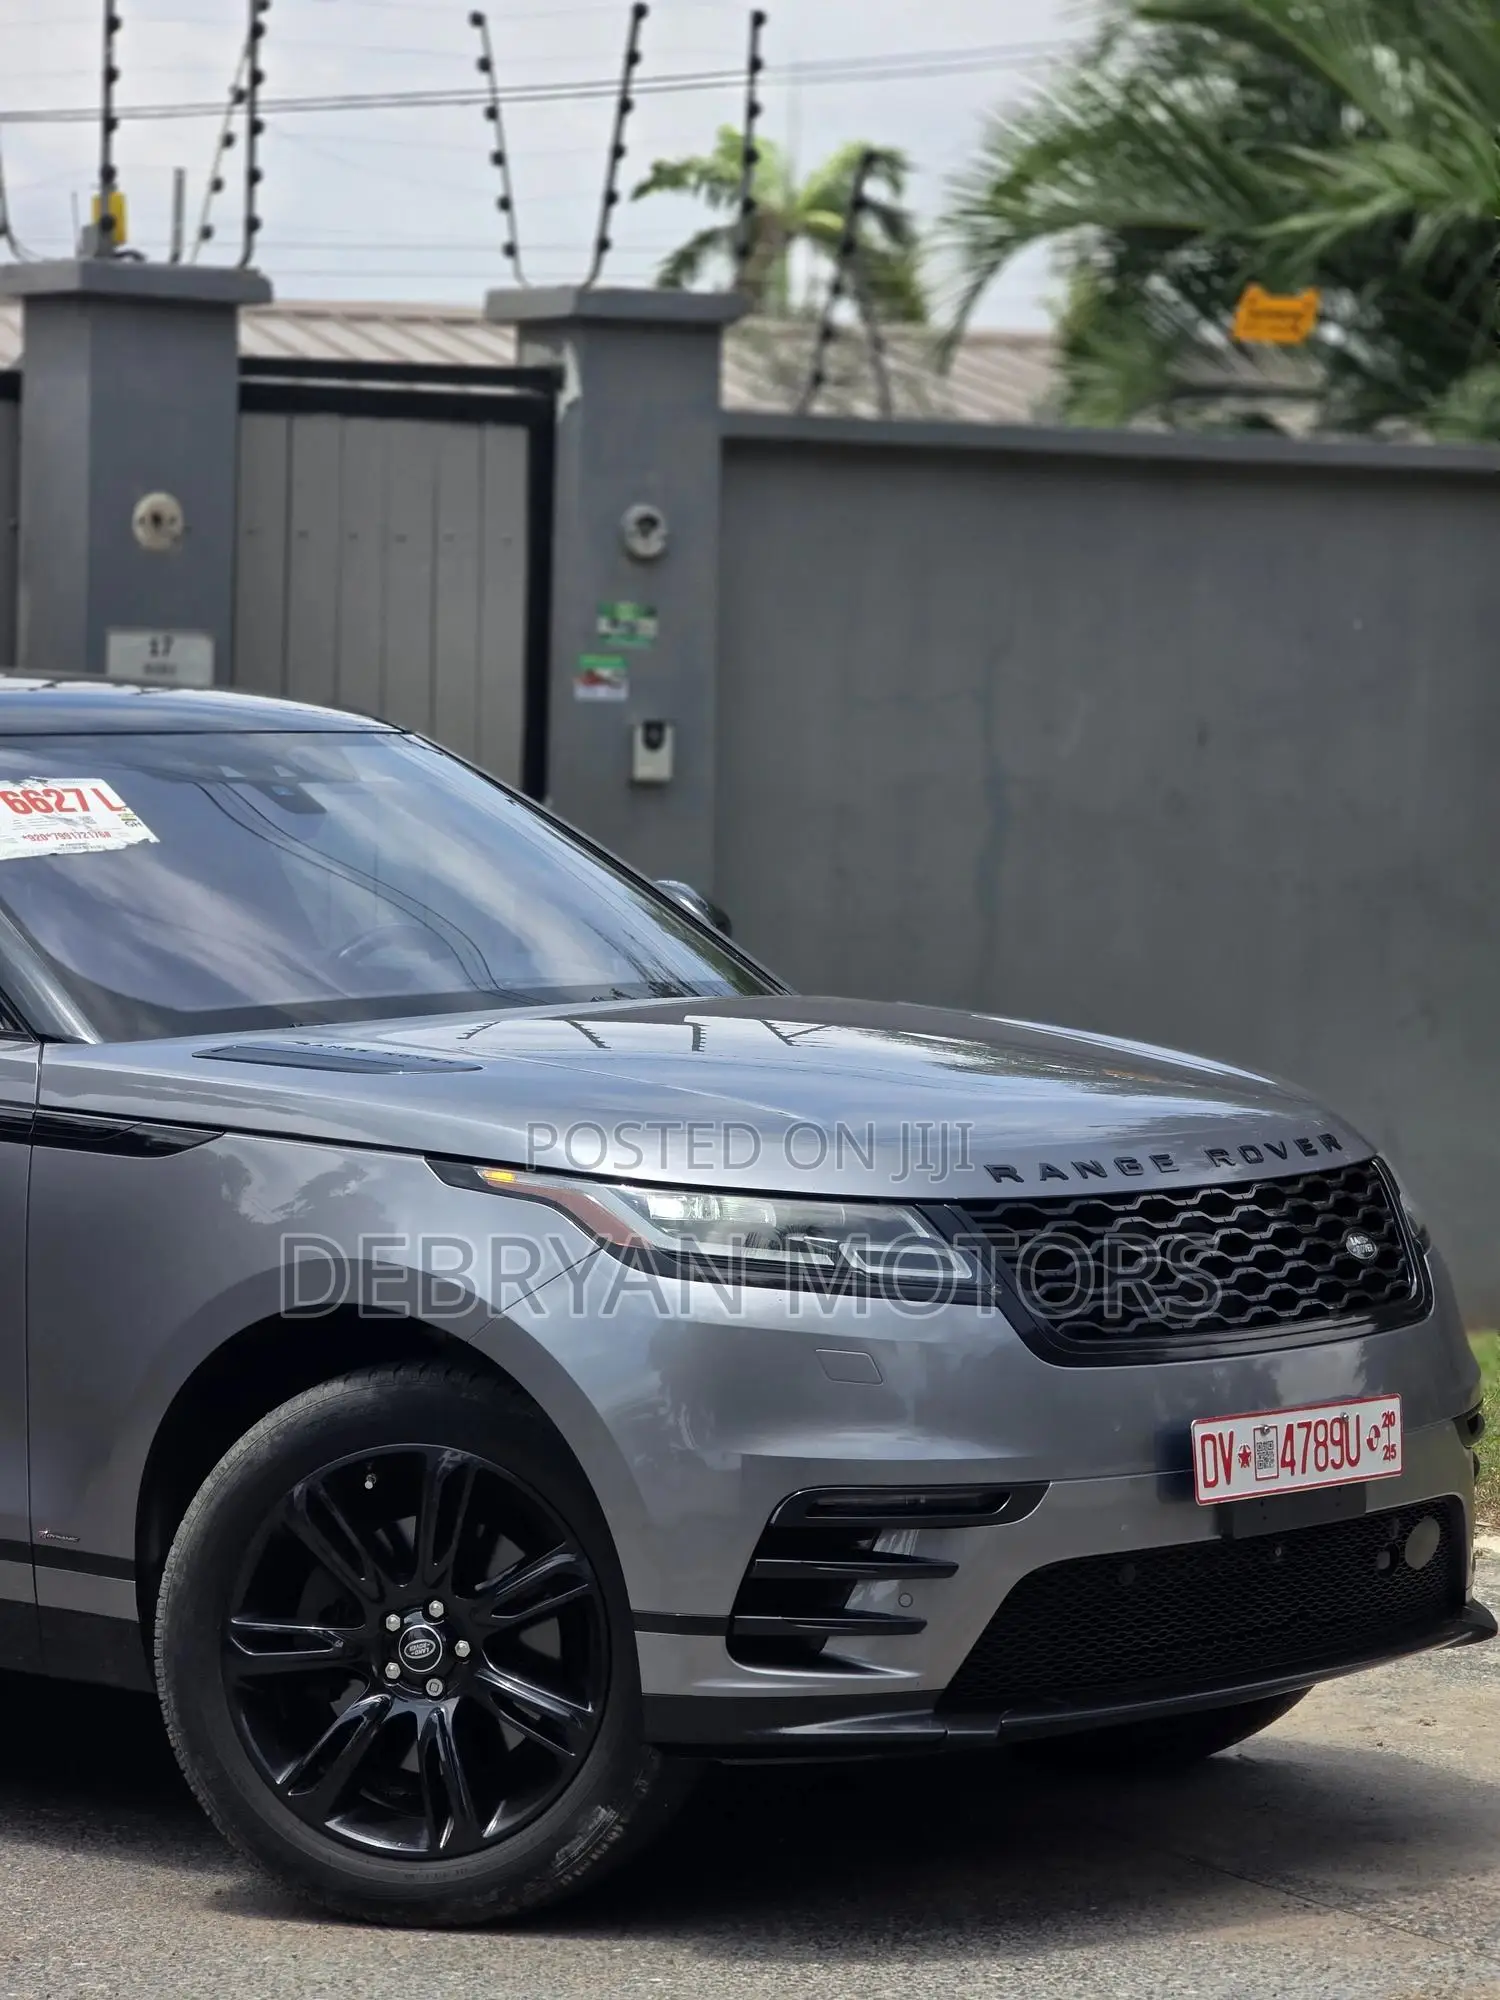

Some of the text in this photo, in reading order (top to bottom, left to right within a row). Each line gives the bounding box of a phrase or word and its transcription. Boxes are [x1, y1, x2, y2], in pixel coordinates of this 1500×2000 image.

[0, 788, 90, 815] 6627
[984, 1132, 1344, 1184] RANGE ROVER
[1381, 1410, 1396, 1429] 20
[1200, 1430, 1234, 1489] DV
[1382, 1443, 1397, 1461] 25
